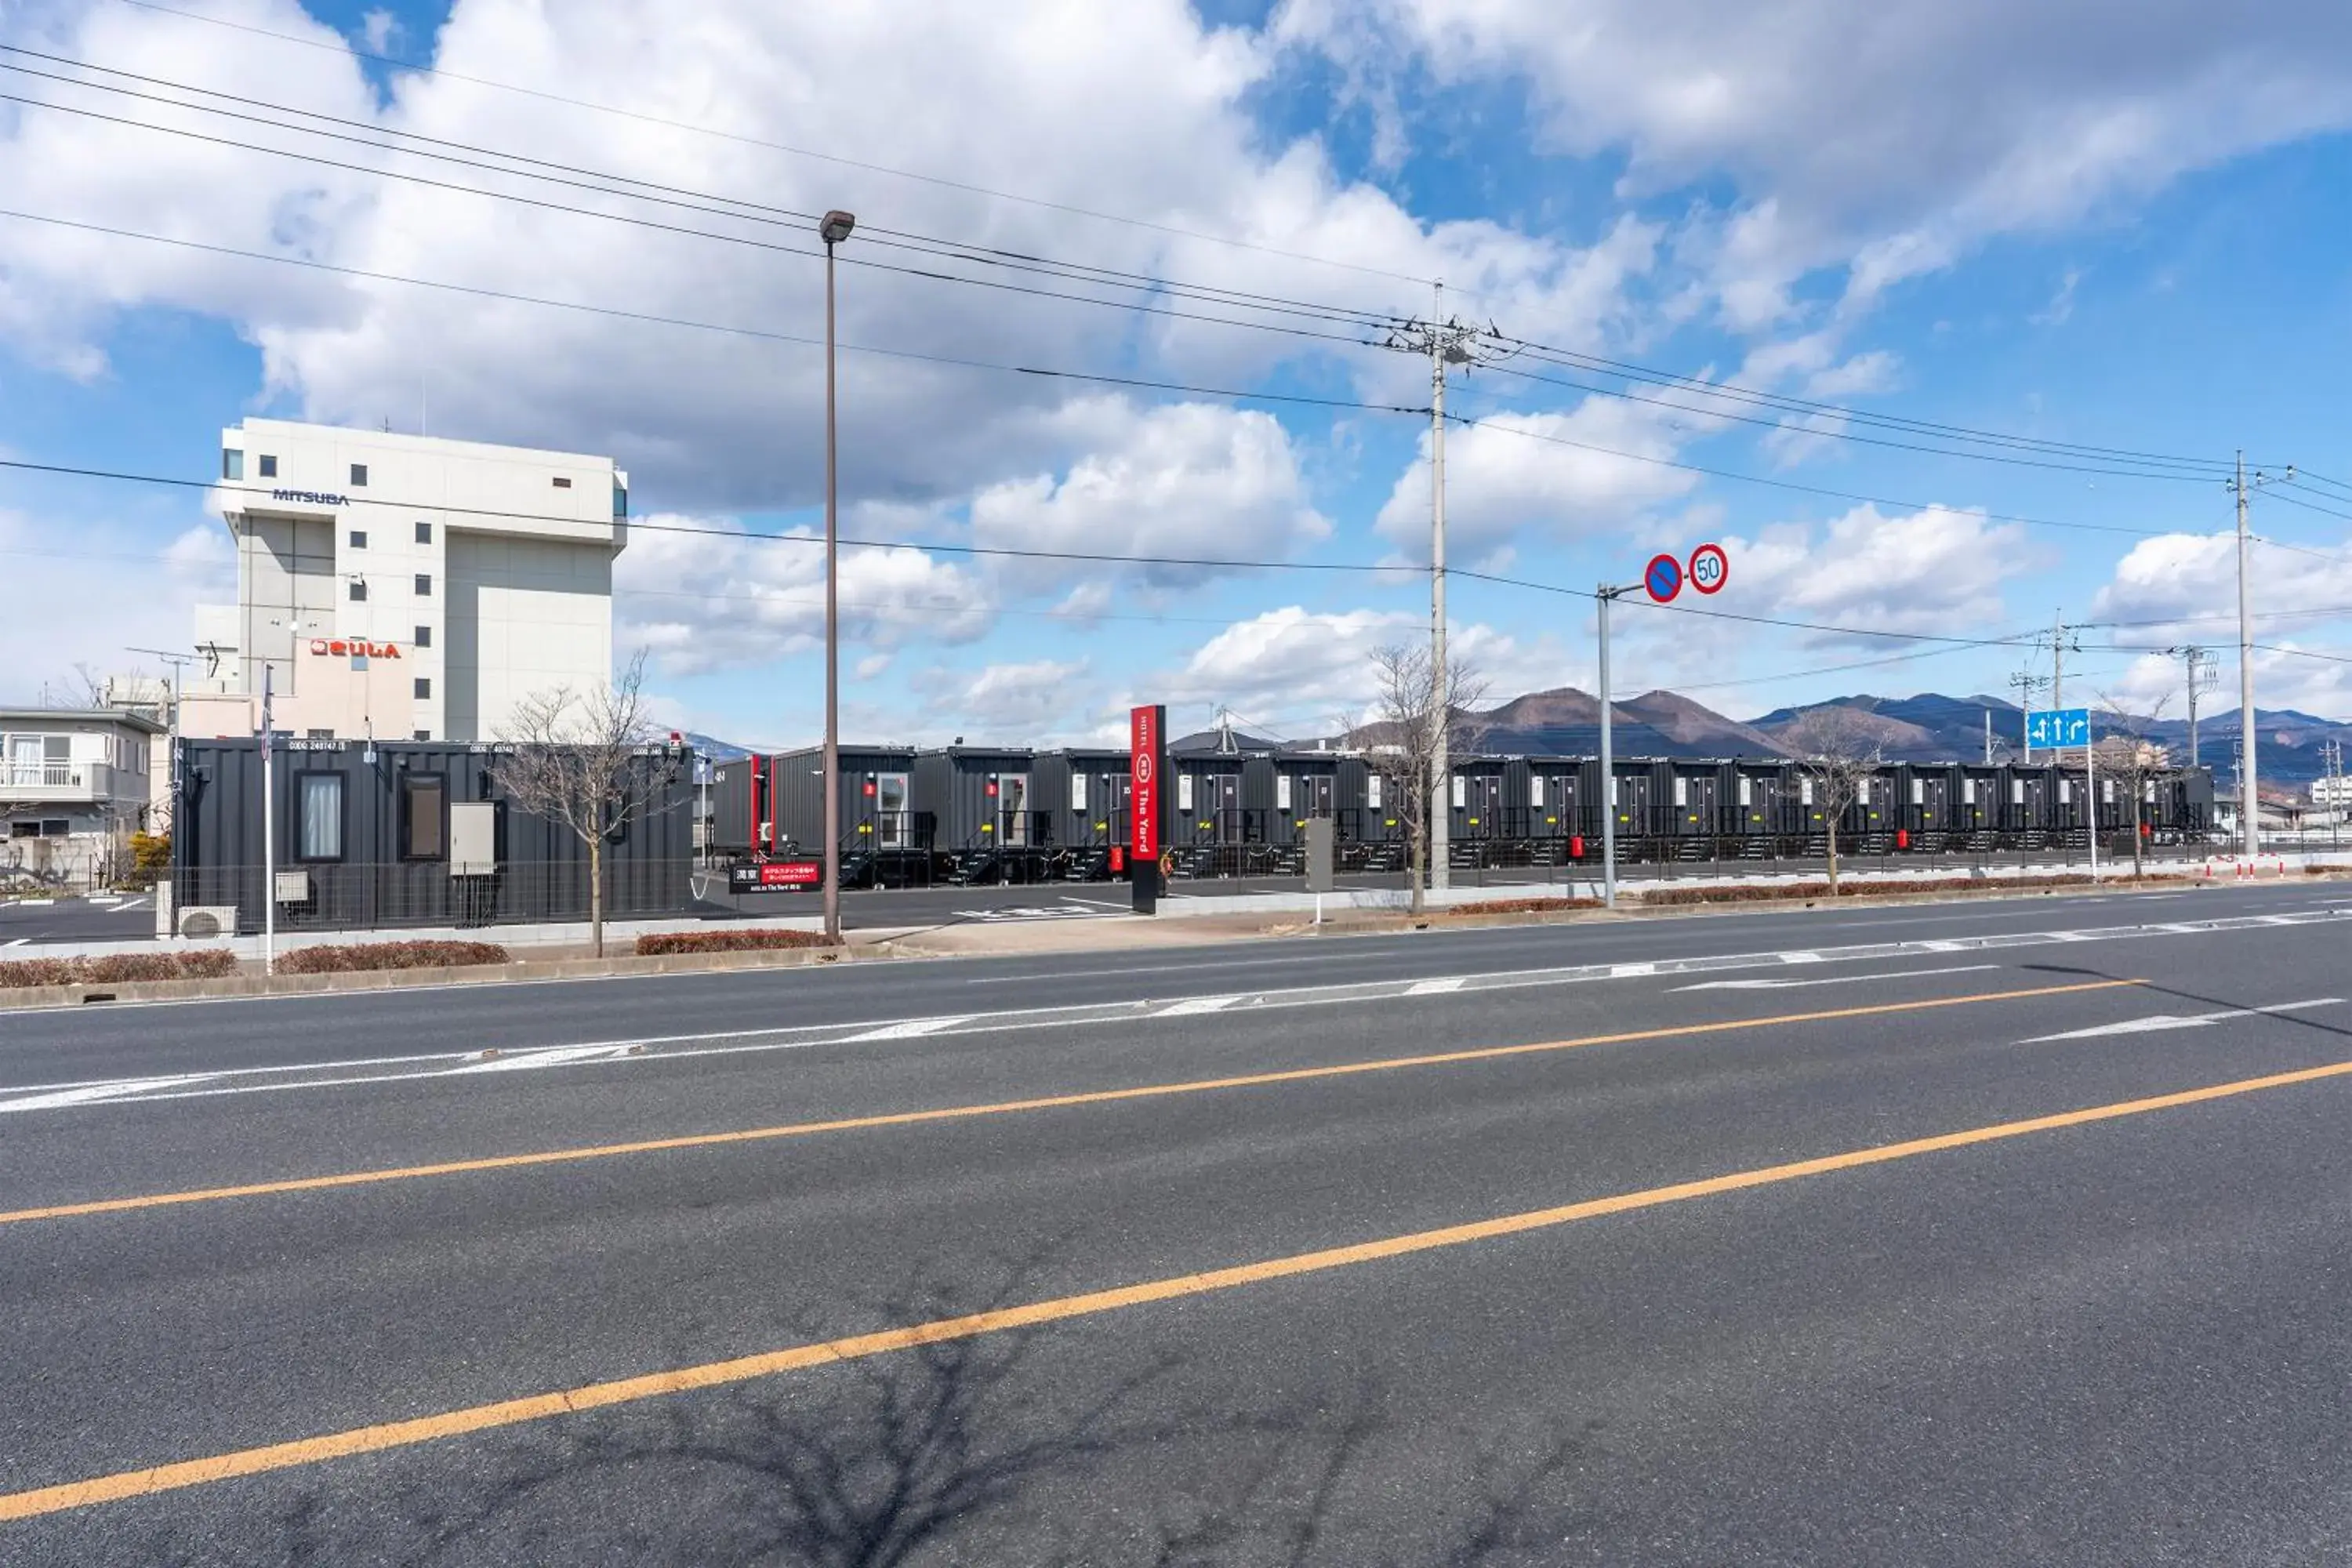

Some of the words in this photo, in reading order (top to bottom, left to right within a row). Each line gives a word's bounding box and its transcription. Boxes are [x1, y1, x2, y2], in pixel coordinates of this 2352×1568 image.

[273, 489, 350, 506] MITSUBA
[1697, 557, 1719, 579] 50
[1139, 788, 1149, 815] The
[1139, 818, 1149, 852] Yard
